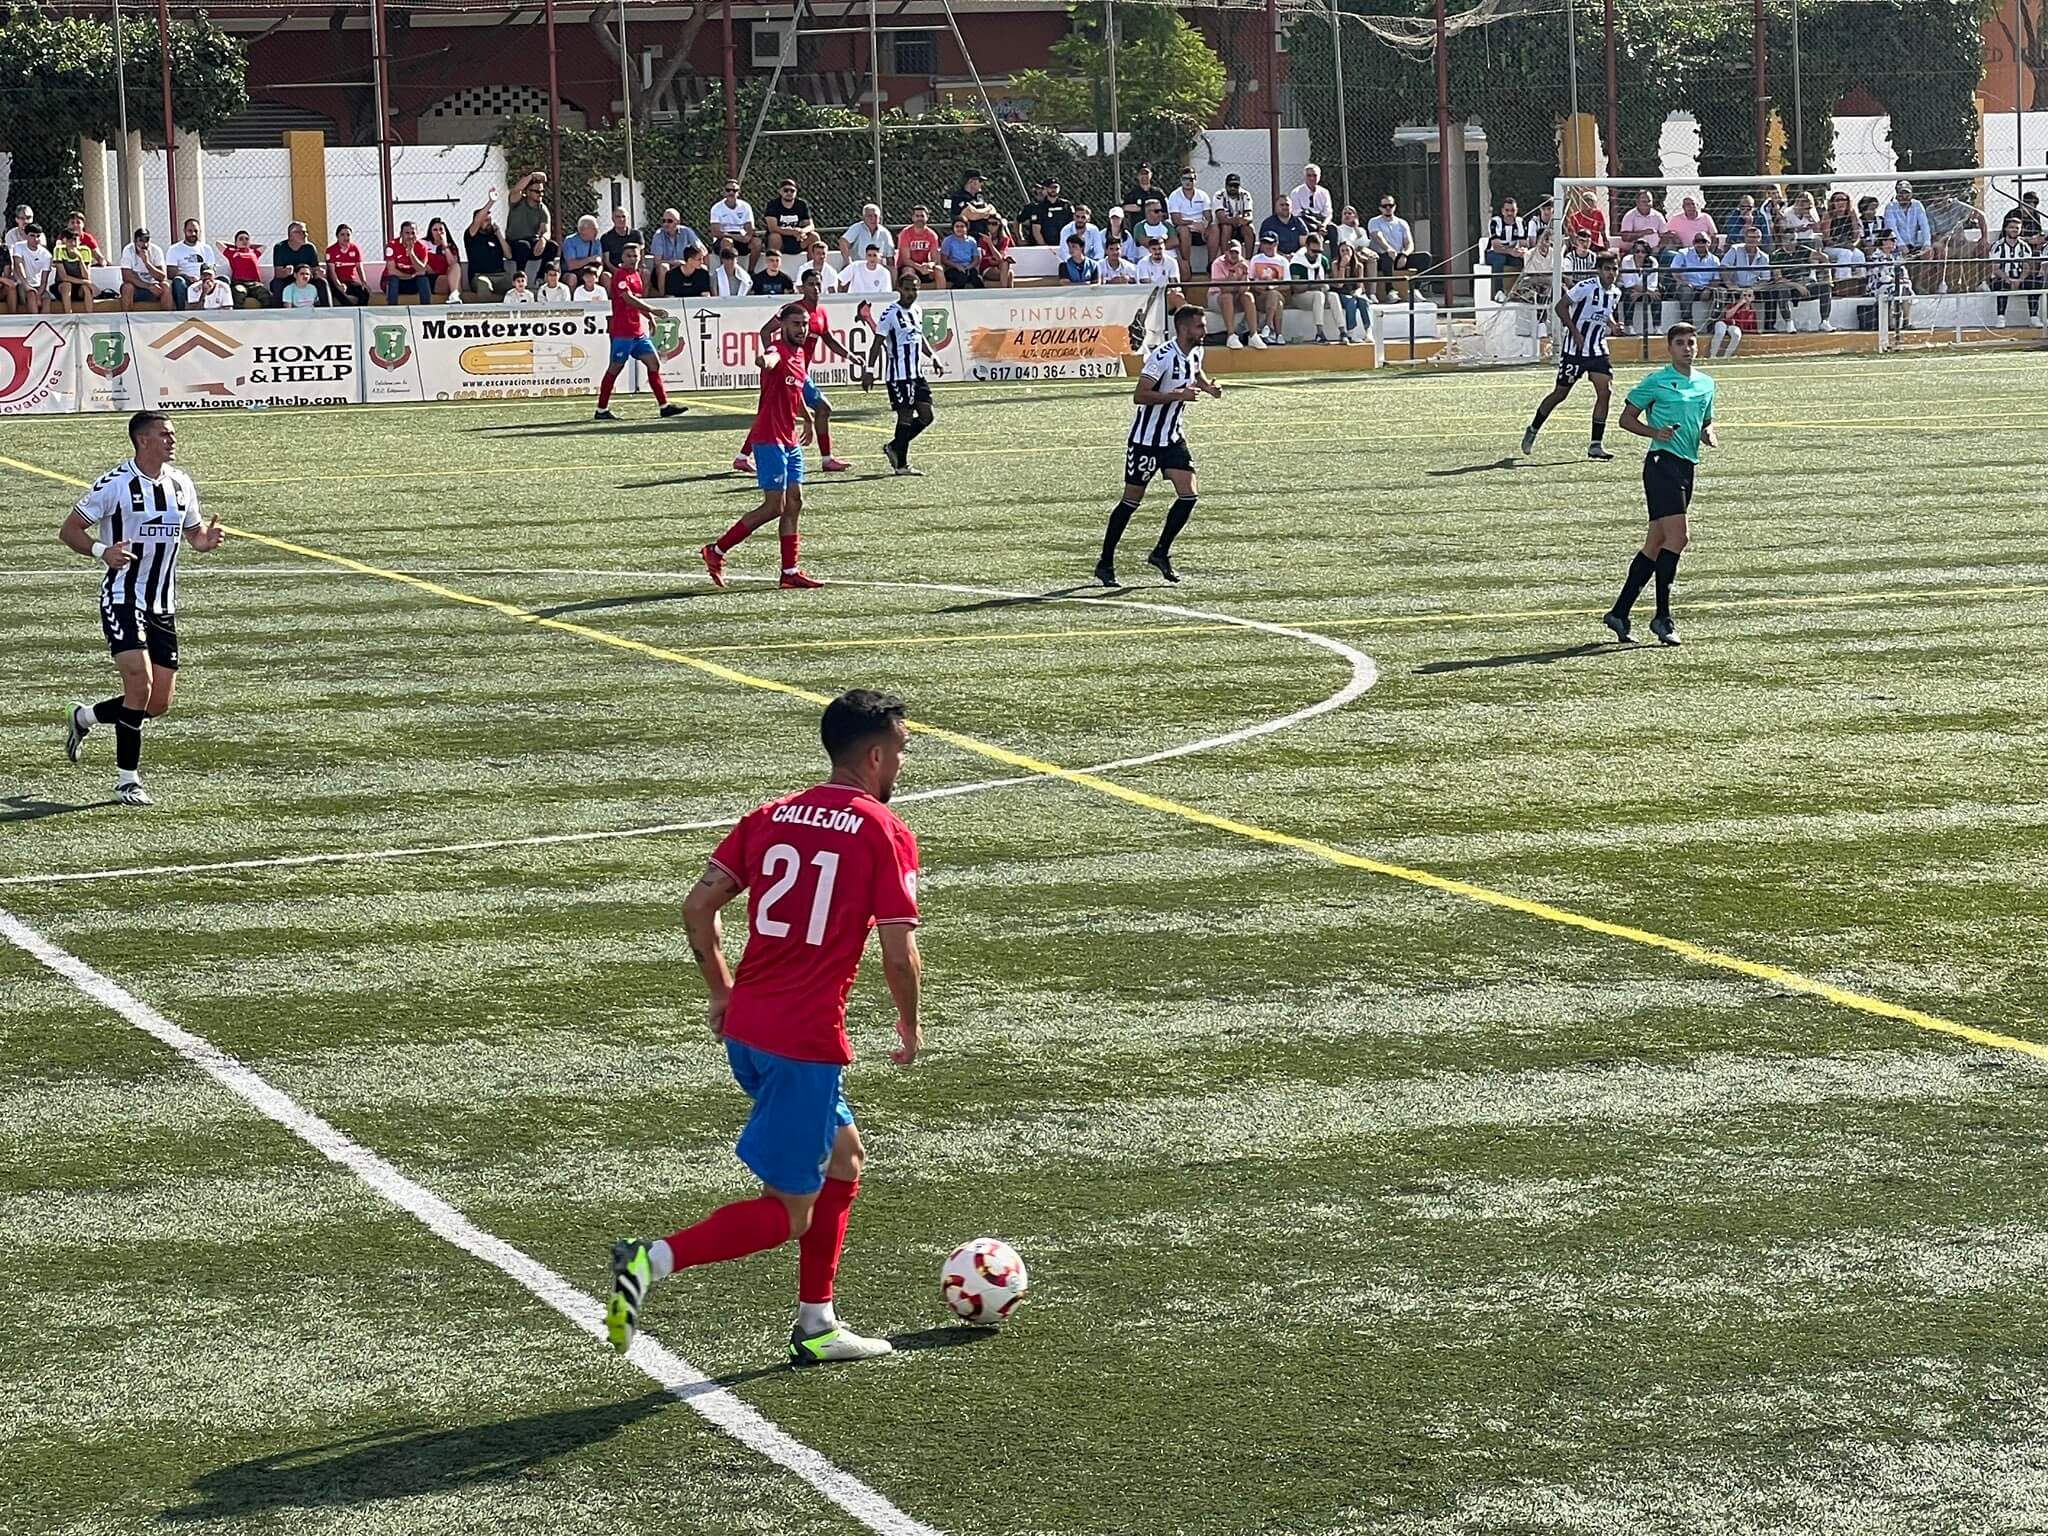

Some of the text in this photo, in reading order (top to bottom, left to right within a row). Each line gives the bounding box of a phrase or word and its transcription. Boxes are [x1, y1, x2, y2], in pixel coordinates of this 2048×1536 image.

[1010, 306, 1104, 322] PINTURAS
[422, 320, 577, 340] Monterroso
[253, 345, 352, 363] HOME
[271, 365, 352, 383] HELP
[990, 367, 1010, 380] 617
[1015, 366, 1038, 379] 040
[1043, 364, 1066, 378] 364
[1565, 364, 1579, 376] 21
[462, 377, 591, 387] www.excavacionessedeno.com
[0, 369, 63, 414] evadores
[158, 396, 348, 409] www.homeandhelp.com
[1138, 456, 1157, 471] 20
[139, 525, 181, 537] LOTUS
[772, 805, 864, 834] CALLEJÓN
[755, 843, 840, 946] 21
